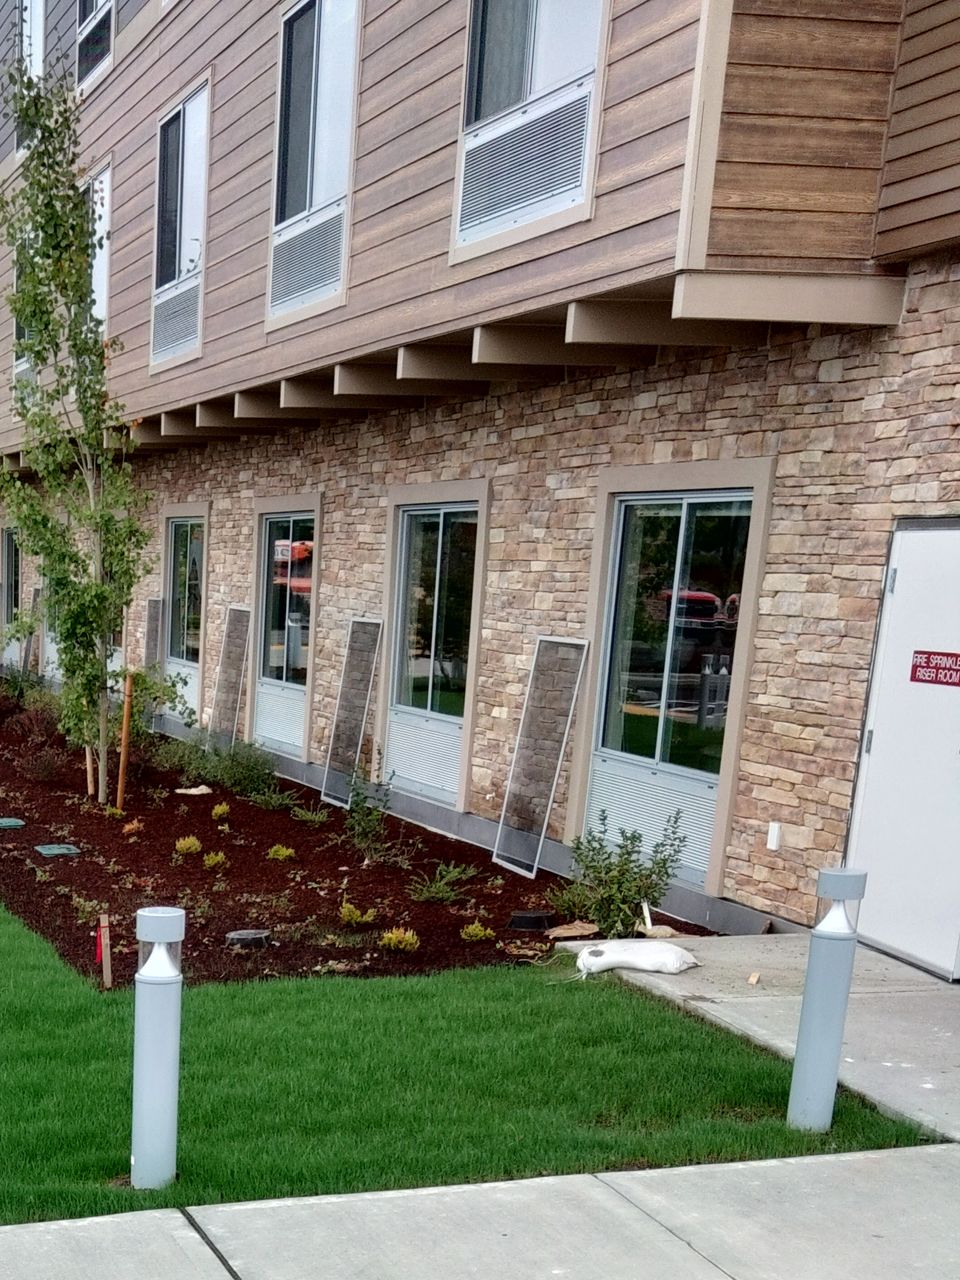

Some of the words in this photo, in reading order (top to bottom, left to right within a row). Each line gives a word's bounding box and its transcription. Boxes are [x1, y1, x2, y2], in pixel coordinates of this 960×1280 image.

[913, 654, 928, 666] FIRE
[916, 667, 936, 681] RISER
[937, 669, 960, 683] ROOM
